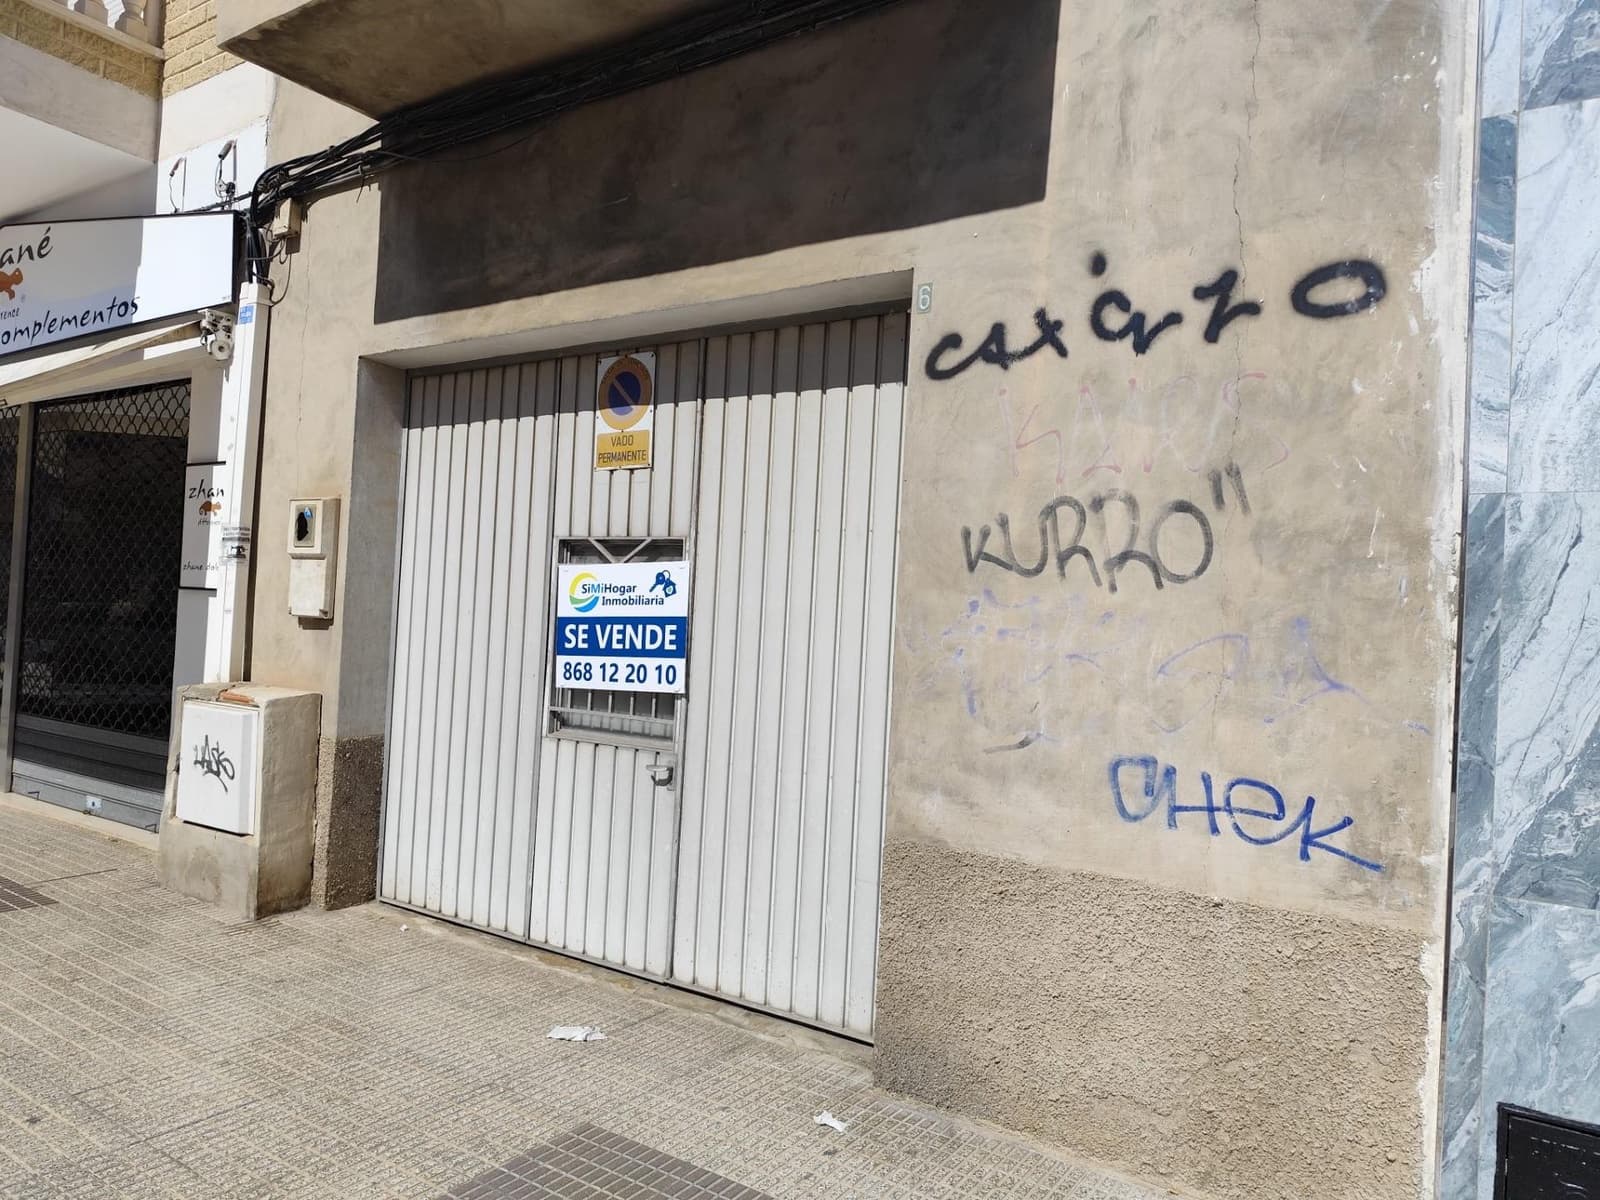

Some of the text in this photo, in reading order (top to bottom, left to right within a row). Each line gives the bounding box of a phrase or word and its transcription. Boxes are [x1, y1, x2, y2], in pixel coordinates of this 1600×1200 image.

[920, 285, 931, 310] 6
[1, 296, 140, 345] omplementos
[611, 434, 634, 447] VADO
[598, 449, 647, 464] PERMANENTE
[581, 583, 637, 596] SiMiHogar
[601, 595, 665, 606] Inmobiliaria
[564, 623, 677, 650] SE VENDE
[563, 661, 677, 685] 868 12 20 10
